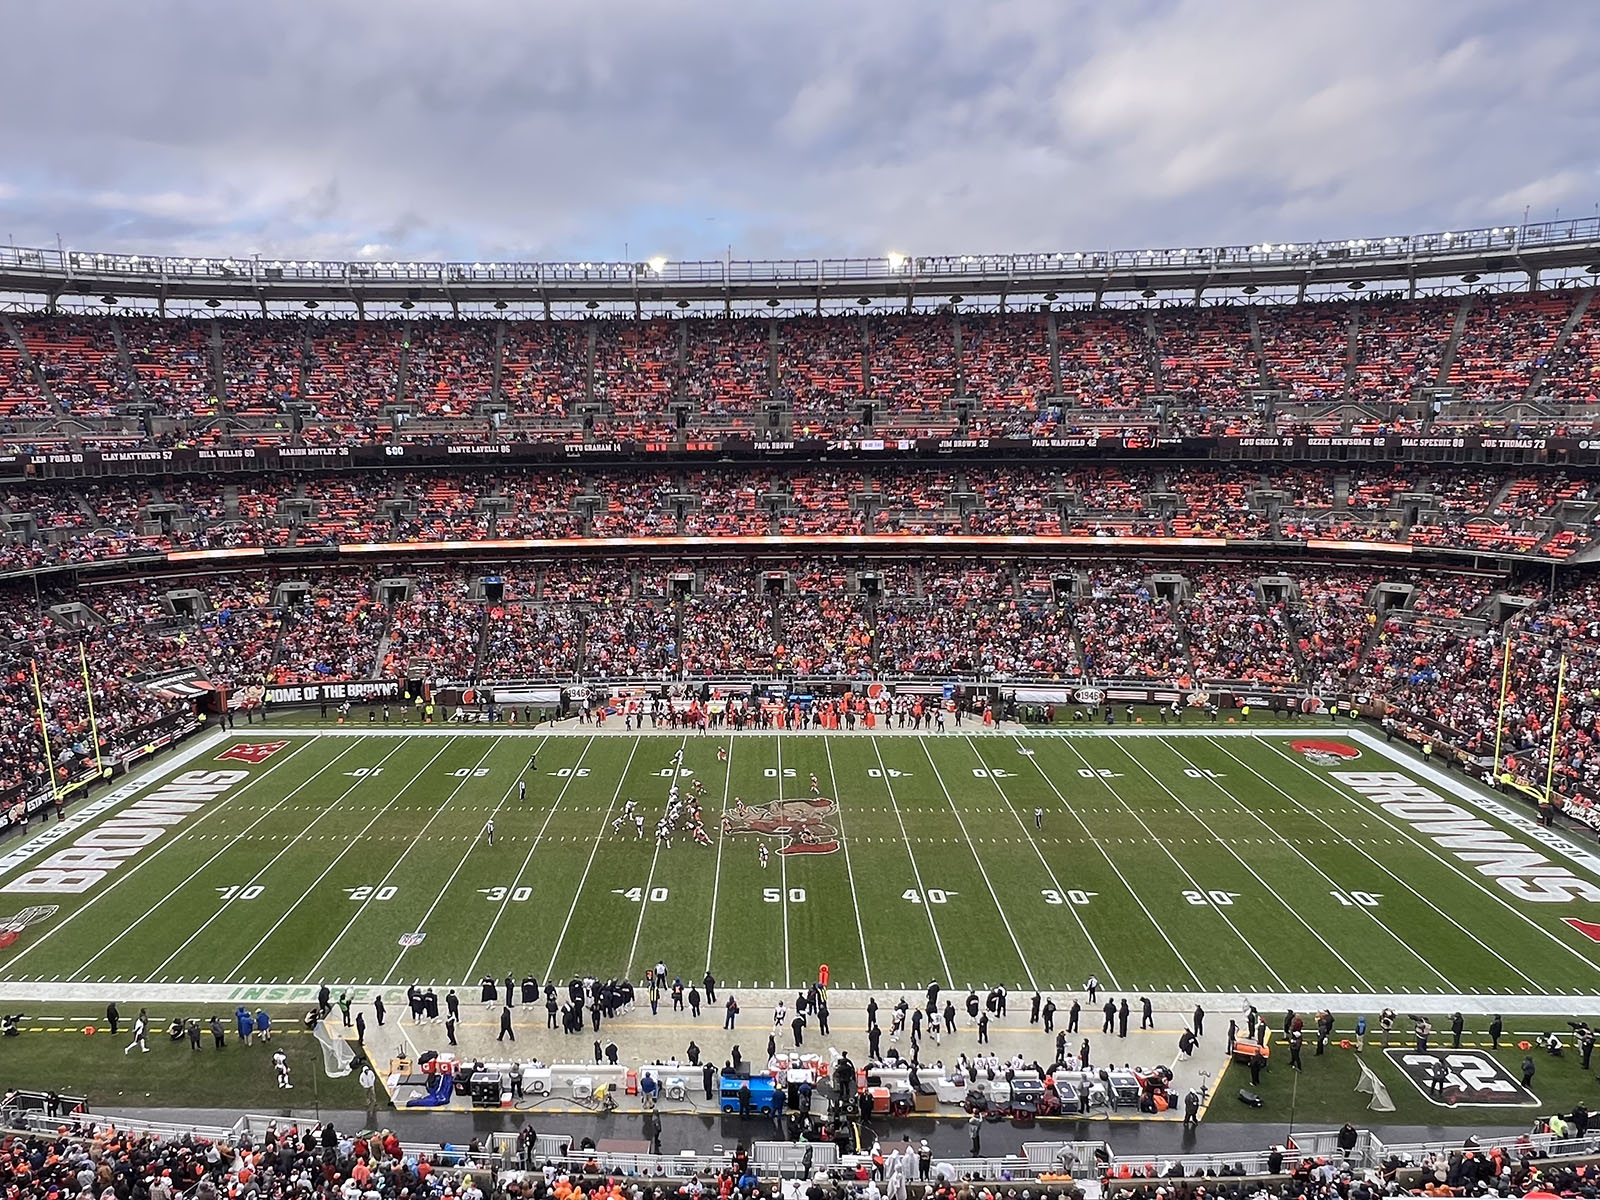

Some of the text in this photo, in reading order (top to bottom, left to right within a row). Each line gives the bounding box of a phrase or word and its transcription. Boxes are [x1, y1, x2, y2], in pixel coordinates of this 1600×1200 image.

[754, 441, 794, 449] PAUL BROWN
[939, 439, 989, 448] JIM BROWN 32
[1032, 439, 1096, 447] PAUL WARFIELD 42
[1255, 438, 1279, 446] GROZA
[1308, 438, 1330, 446] OZZIE
[1331, 438, 1371, 446] NEWSOME
[1401, 438, 1418, 447] MAC
[1419, 438, 1451, 447] SPEEDIE
[1481, 439, 1546, 448] JOE THOMAS 73
[308, 448, 337, 456] MOTLEY
[448, 446, 471, 454] DANTE
[472, 445, 499, 453] LAVELLI
[565, 443, 621, 452] OTTO GRAHAM 14
[102, 451, 173, 461] CLAY MATTHEWS 57
[199, 450, 216, 458] BILL
[217, 449, 243, 458] WILLIS
[50, 454, 71, 463] FORD
[304, 686, 319, 701] OF
[322, 685, 346, 699] THE
[568, 687, 586, 697] 1946
[1080, 691, 1100, 700] 1946
[352, 768, 384, 777] 10
[454, 768, 490, 777] 20
[556, 768, 592, 777] 30
[660, 768, 694, 777] 40
[764, 768, 797, 778] 50
[867, 768, 902, 778] 40
[972, 768, 1008, 777] 30
[1077, 768, 1115, 777] 20
[1183, 768, 1218, 777] 10
[9, 825, 71, 859] TAKES
[71, 806, 105, 823] ALL
[105, 793, 125, 805] OF
[1472, 798, 1591, 858] END RACISM
[0, 770, 250, 893] BROWNS
[1328, 771, 1600, 902] BROWNS
[220, 885, 265, 900] 10
[348, 886, 398, 901] 20
[486, 887, 532, 901] 30
[624, 887, 669, 902] 40
[763, 888, 806, 903] 50
[901, 888, 947, 904] 40
[1041, 889, 1090, 905] 30
[1182, 890, 1234, 905] 20
[1330, 891, 1379, 906] 10
[228, 987, 370, 1001] INSPRE
[1402, 1054, 1518, 1093] 32
